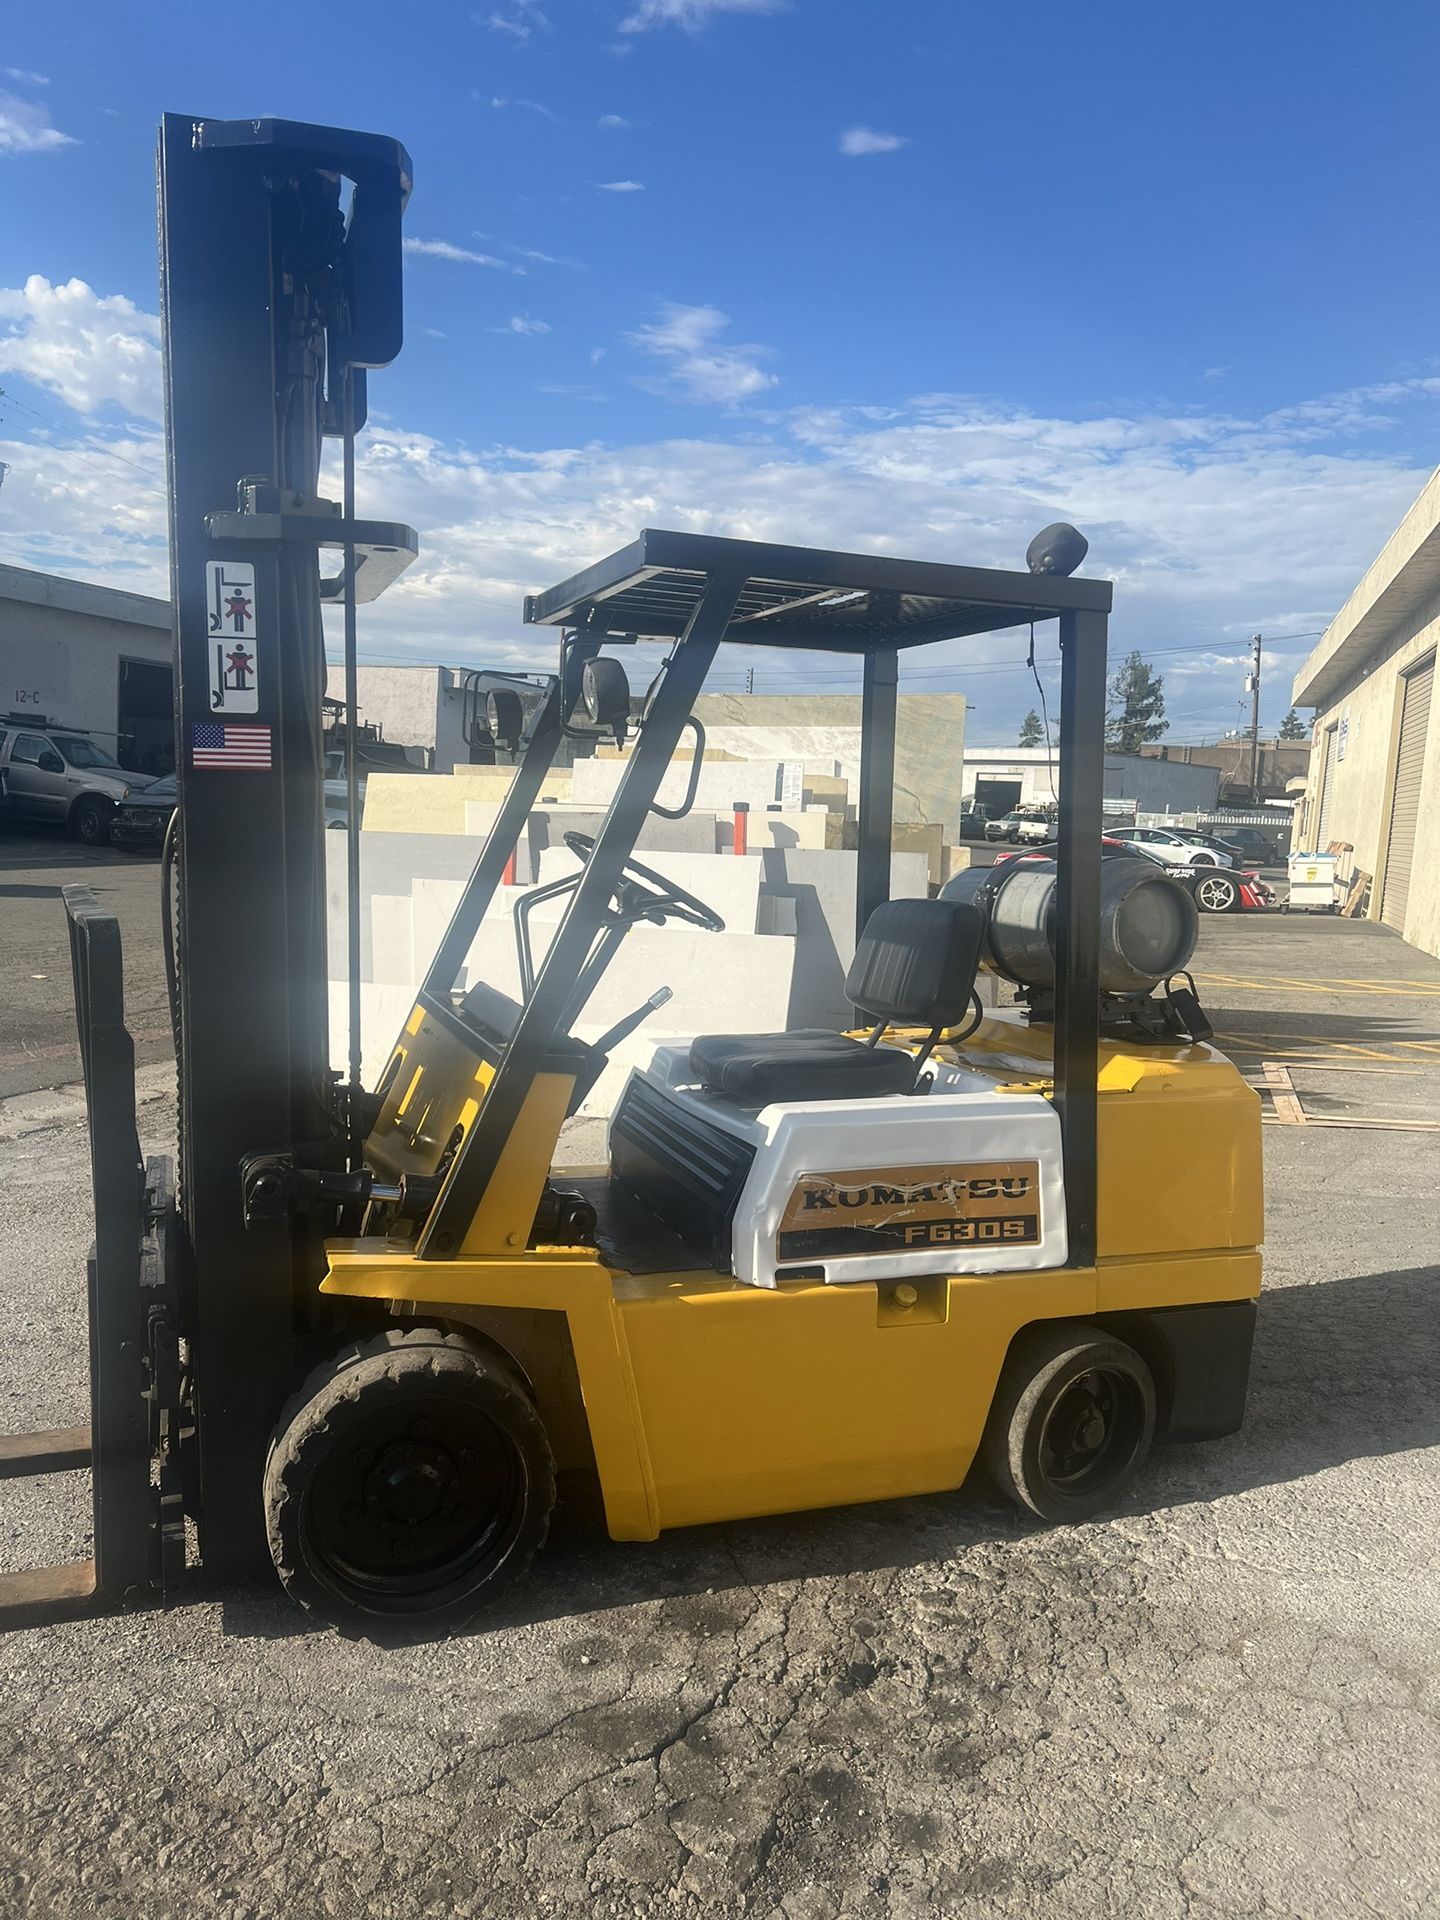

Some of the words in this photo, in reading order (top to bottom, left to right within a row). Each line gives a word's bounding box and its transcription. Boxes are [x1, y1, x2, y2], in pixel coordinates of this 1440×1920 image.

[15, 689, 40, 704] 12-C
[802, 1177, 1029, 1210] KOMATSU
[905, 1219, 1025, 1244] FG30S
